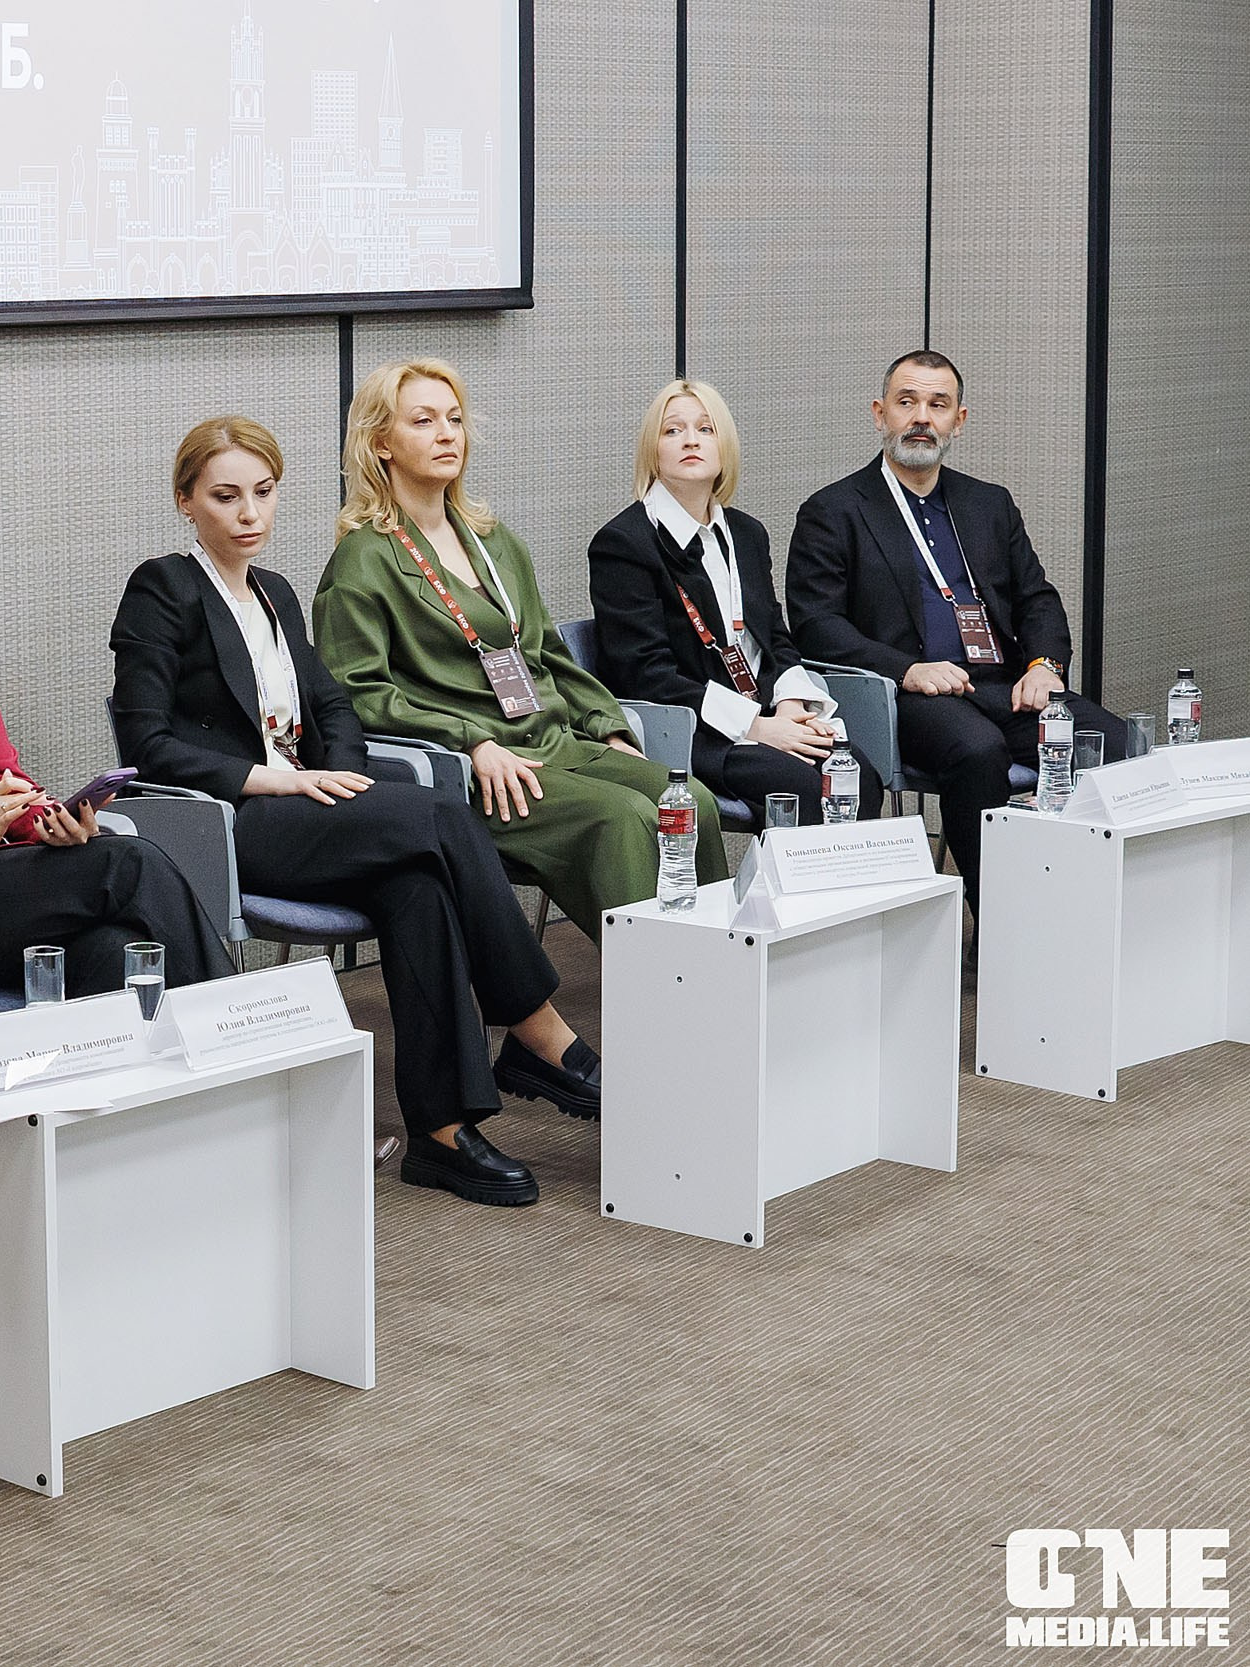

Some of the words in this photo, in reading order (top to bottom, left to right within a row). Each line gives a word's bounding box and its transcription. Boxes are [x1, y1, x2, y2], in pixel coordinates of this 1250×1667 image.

[785, 846, 832, 858] Конышева
[832, 842, 865, 853] Оксана
[865, 836, 915, 849] Васильевна
[216, 1017, 246, 1033] Юлия
[246, 1003, 311, 1026] Владимировна
[62, 1032, 135, 1055] Владимировна
